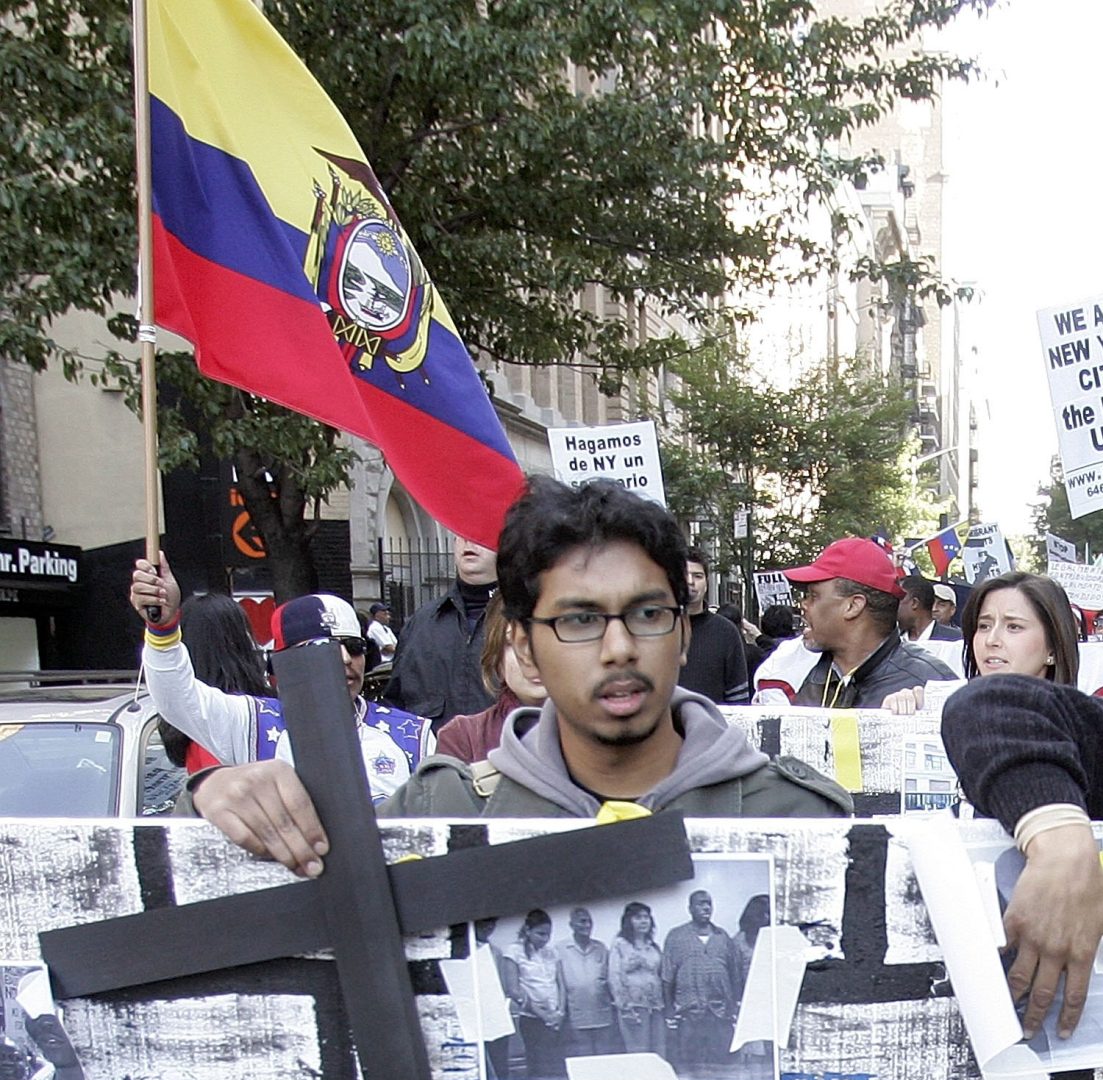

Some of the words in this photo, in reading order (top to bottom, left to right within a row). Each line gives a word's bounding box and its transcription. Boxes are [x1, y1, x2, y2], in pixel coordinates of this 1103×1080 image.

[1053, 308, 1087, 336] WE
[1048, 338, 1090, 370] NEW
[1062, 404, 1095, 431] the
[564, 434, 642, 455] Hagamos
[569, 457, 588, 472] de
[593, 454, 616, 471] NY
[624, 454, 644, 468] un
[18, 547, 78, 583] Parking
[757, 573, 785, 584] FULL
